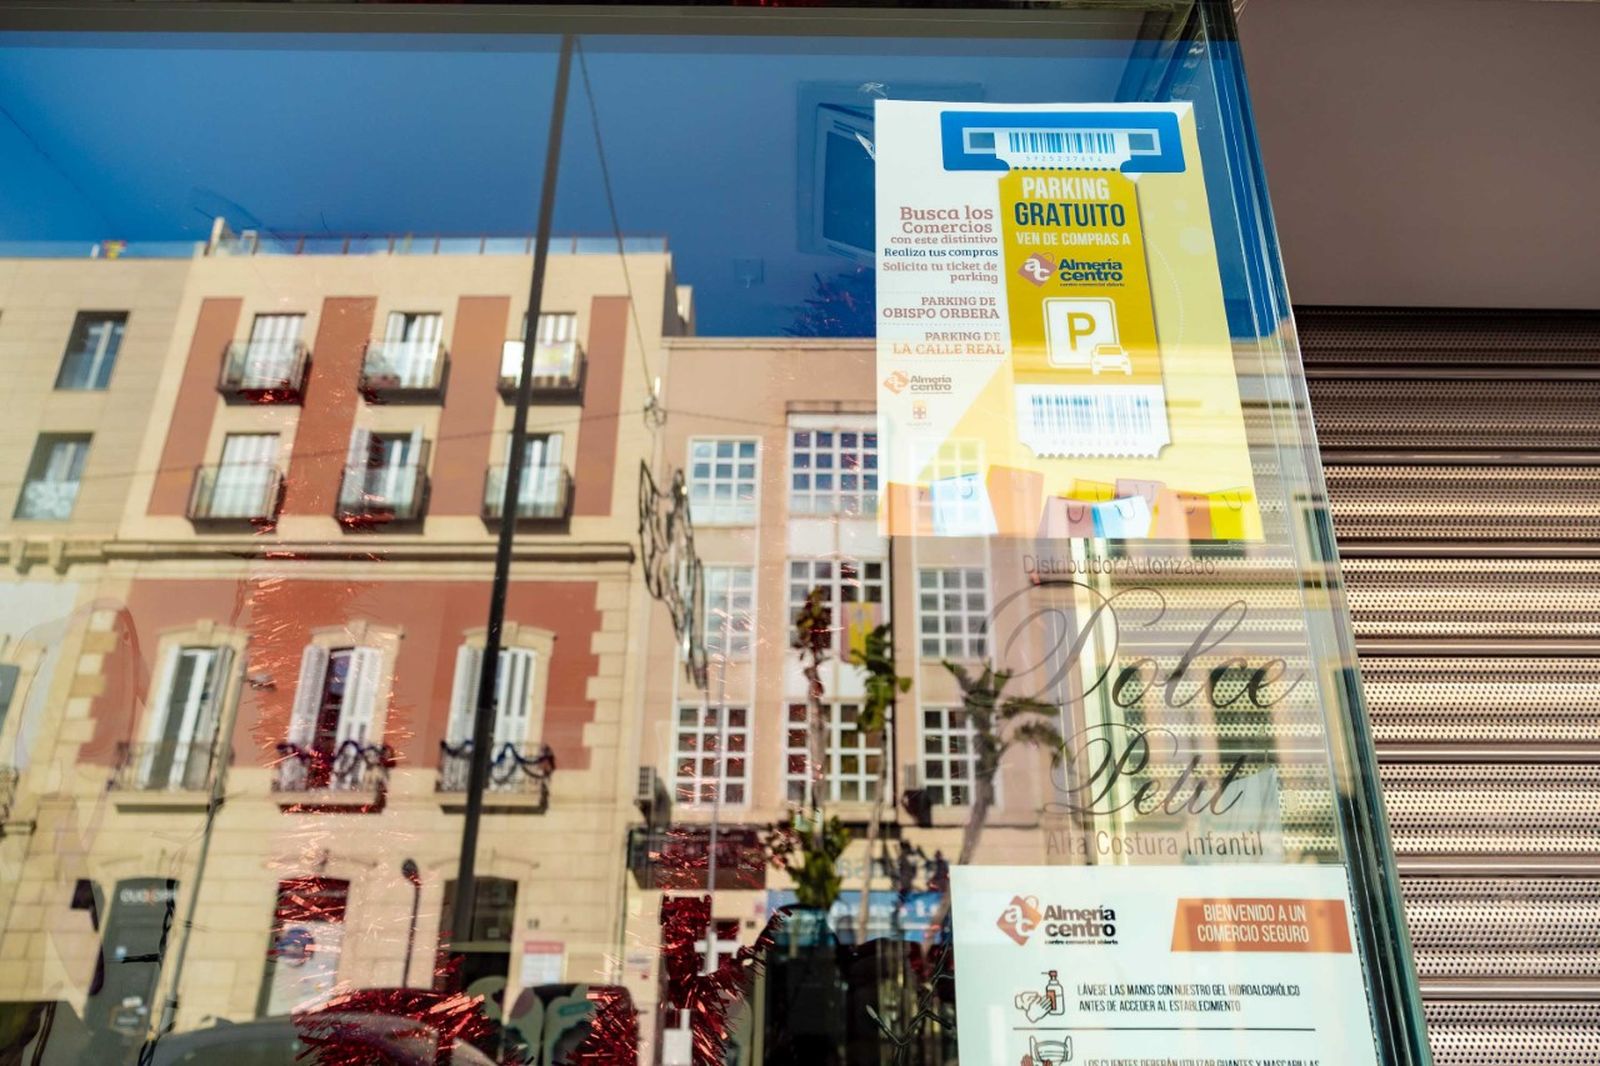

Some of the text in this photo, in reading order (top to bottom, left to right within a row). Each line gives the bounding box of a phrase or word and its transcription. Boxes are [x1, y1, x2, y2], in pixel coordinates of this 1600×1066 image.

[1021, 177, 1110, 200] PARKING
[900, 204, 994, 221] Busca los
[1014, 202, 1126, 227] GRATUITO
[902, 221, 993, 234] Comercios
[890, 234, 998, 244] con este distintivo
[1015, 232, 1132, 246] VEN DE COMPRAS A
[884, 248, 999, 258] Realiza tus compras
[883, 261, 998, 271] Solicita tu ticket de
[1058, 258, 1123, 270] Almería
[950, 272, 999, 284] parking
[1060, 269, 1123, 281] centro
[921, 296, 996, 306] PARKING DE
[883, 307, 1000, 319] OBISPO ORBERA
[925, 332, 1002, 341] PARKING DE
[1066, 311, 1097, 352] P
[893, 343, 1005, 355] LA CALLE REAL
[910, 382, 952, 391] centro
[1023, 555, 1119, 574] Distribuidor
[964, 580, 1305, 708] Dolce
[1037, 722, 1244, 816] Petit
[1046, 830, 1264, 856] Alta Costura Infantil
[1043, 905, 1116, 921] Almería
[1203, 904, 1307, 922] BIENVENIDO A UN
[1045, 921, 1116, 937] centro
[1197, 924, 1310, 943] COMERCIO SEGURO
[1077, 982, 1301, 996] LÁVESE LAS MANOS CON NUESTRO GEL HIDROALCOHÓLICO
[1079, 1000, 1241, 1012] ANTES DE ACCEDER AL ESTABLECIMIENTO
